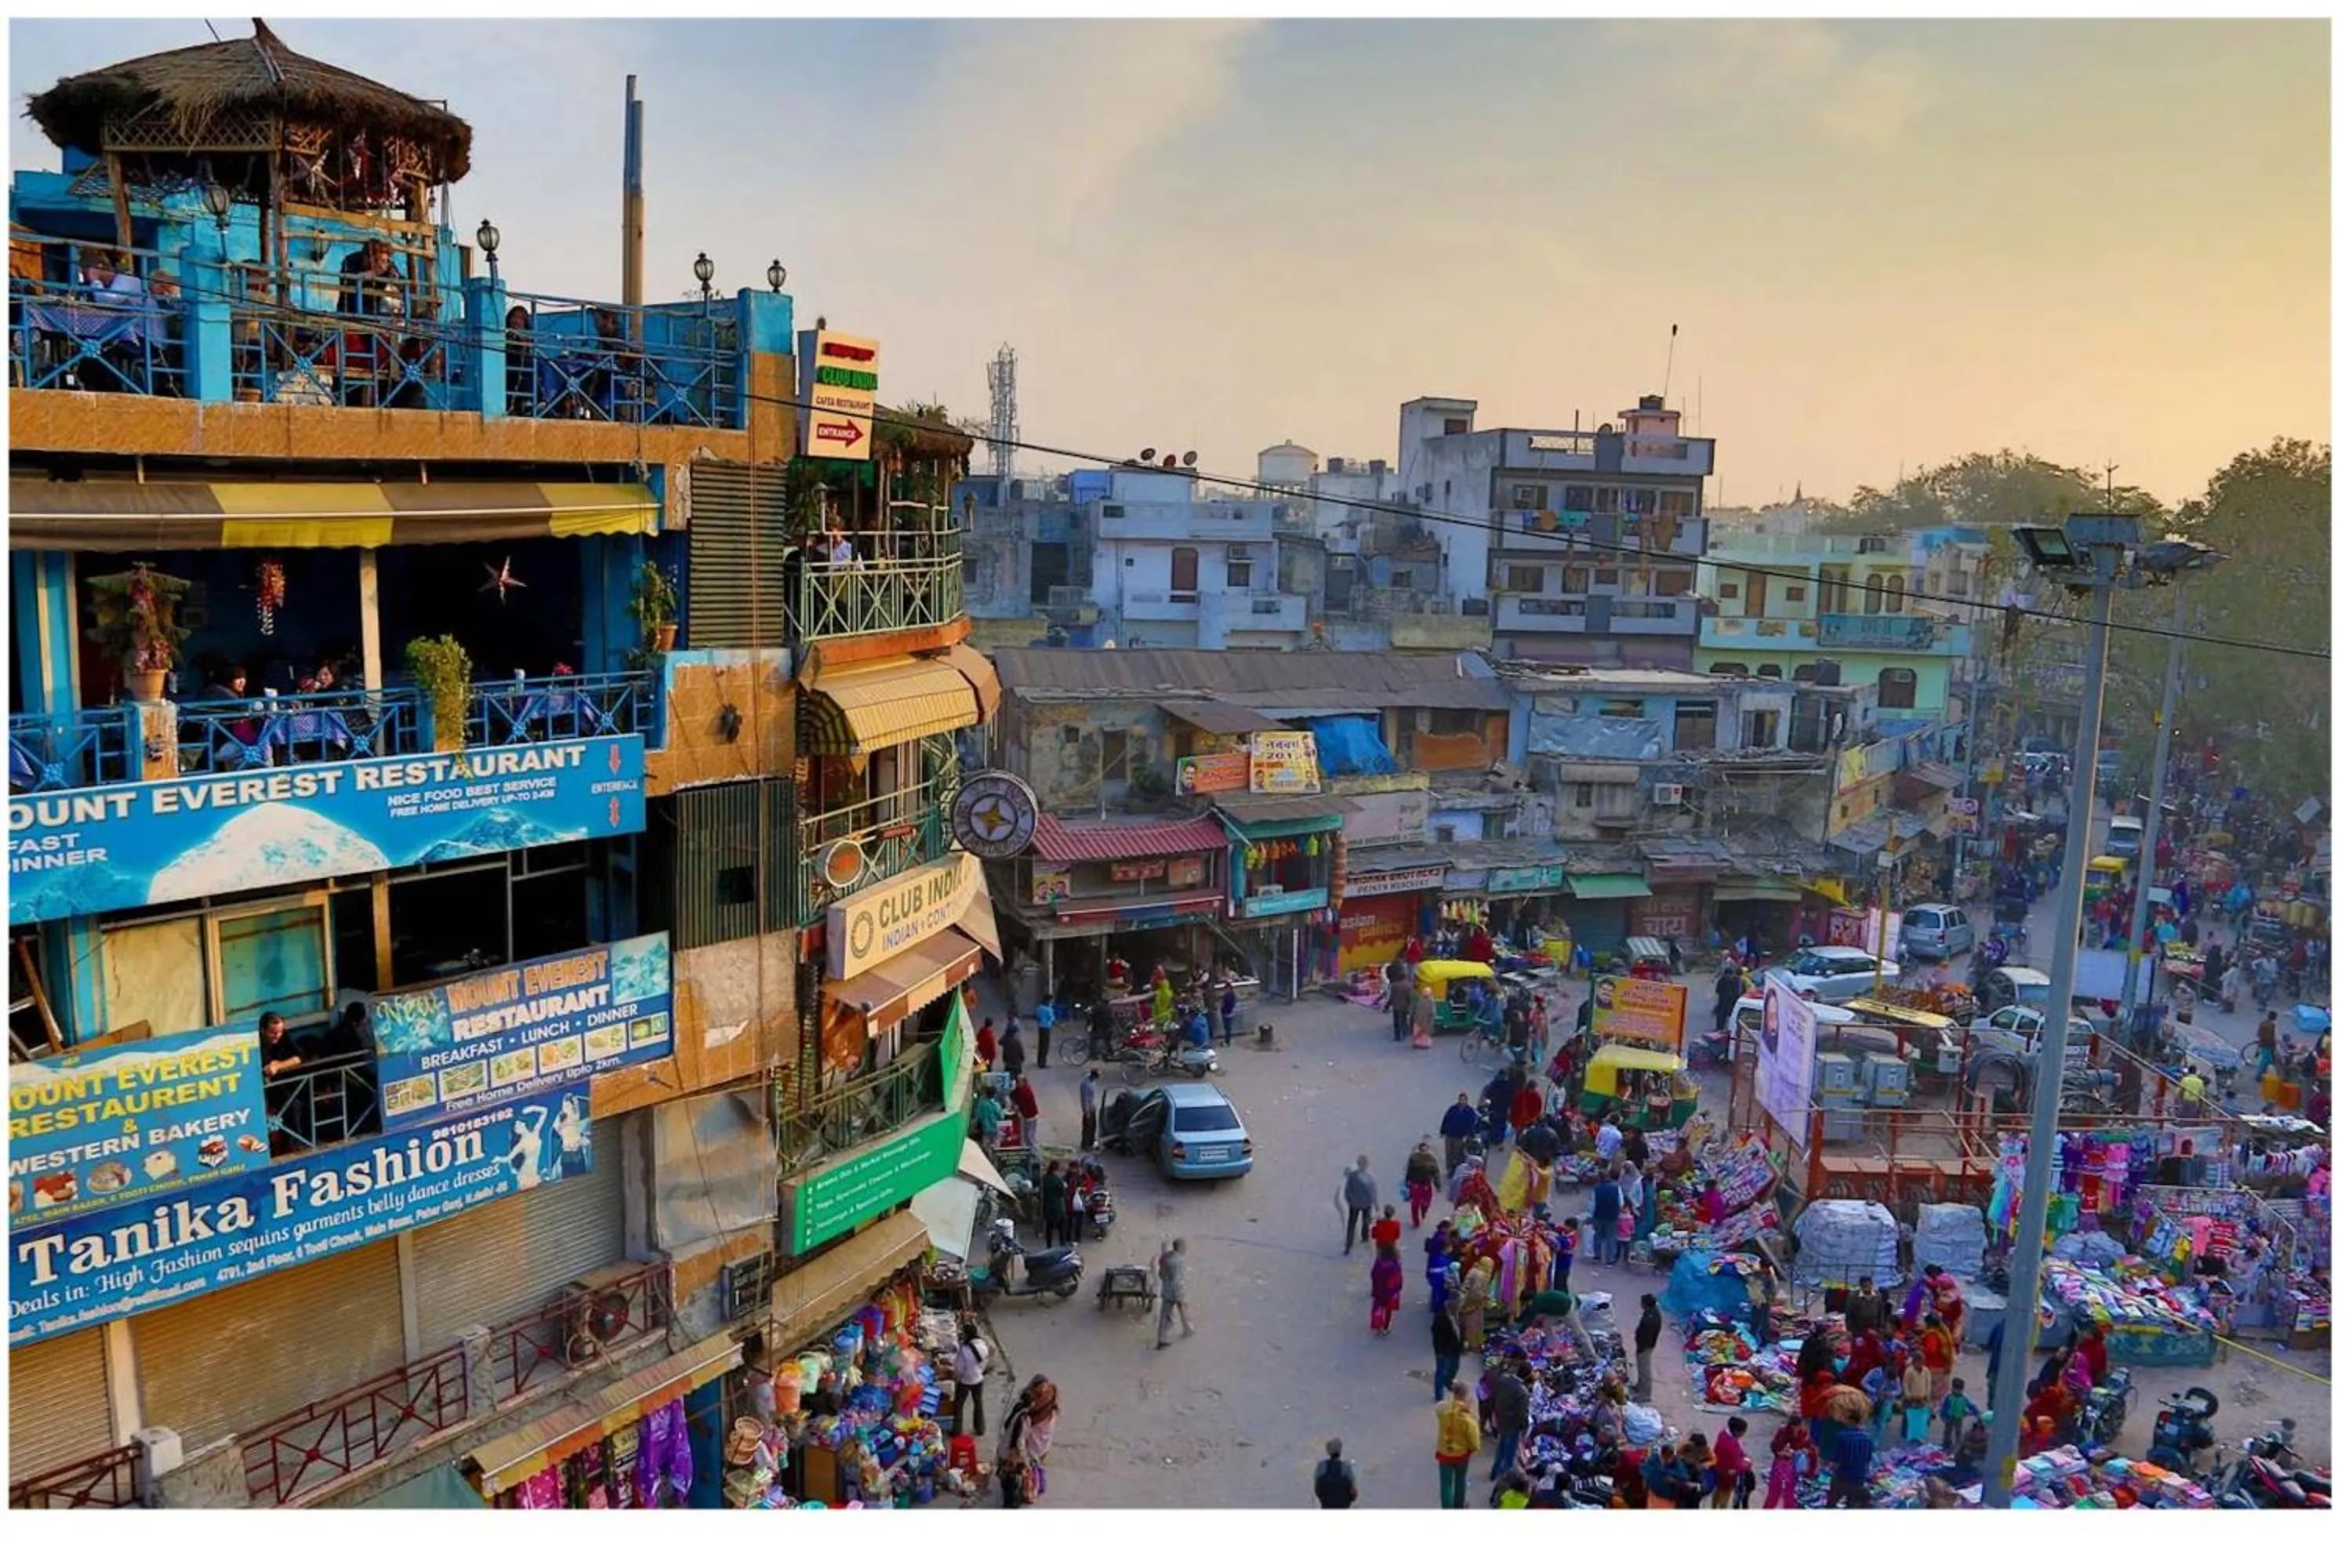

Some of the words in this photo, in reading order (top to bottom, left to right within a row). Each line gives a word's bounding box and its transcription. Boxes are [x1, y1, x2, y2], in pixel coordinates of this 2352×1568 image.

[818, 426, 856, 438] ENTRANCE
[152, 769, 343, 814] EVEREST
[356, 745, 586, 790] RESTAURANT
[387, 793, 421, 807] NICE
[424, 787, 463, 803] FOOD
[466, 782, 500, 797] BEST
[503, 777, 557, 792] SERVICE
[390, 806, 419, 818] FREE
[420, 801, 451, 814] HOME
[452, 796, 500, 811] DELIVERY
[9, 848, 108, 873] INNER
[879, 884, 923, 928] CLUB
[882, 920, 918, 953] INDIAN
[445, 970, 521, 1014] MOUNT
[523, 951, 608, 996] EVEREST
[421, 1038, 503, 1070] BREAKFAST
[521, 1020, 570, 1044] LUNCH
[587, 1003, 638, 1026] DINNER
[452, 985, 610, 1042] RESTAURANT
[9, 1071, 106, 1113] OUNT
[118, 1041, 256, 1091] EVEREST
[445, 1098, 472, 1112] Free
[476, 1087, 514, 1103] Home
[517, 1071, 564, 1091] Delivery
[9, 1073, 242, 1139] RESTAURENT
[122, 1118, 139, 1134] &
[9, 1133, 140, 1177] WESTERN
[149, 1108, 252, 1145] BAKERY
[18, 1196, 255, 1287] Tanika
[270, 1130, 485, 1218] Fashion
[9, 1290, 60, 1319] Deals
[65, 1284, 90, 1302] in:
[94, 1265, 143, 1295] High
[150, 1247, 223, 1283] Fashion
[227, 1226, 289, 1256] sequins
[292, 1205, 365, 1240] garments
[368, 1191, 405, 1217] belly
[407, 1178, 451, 1202] dance
[454, 1163, 500, 1189] dresses
